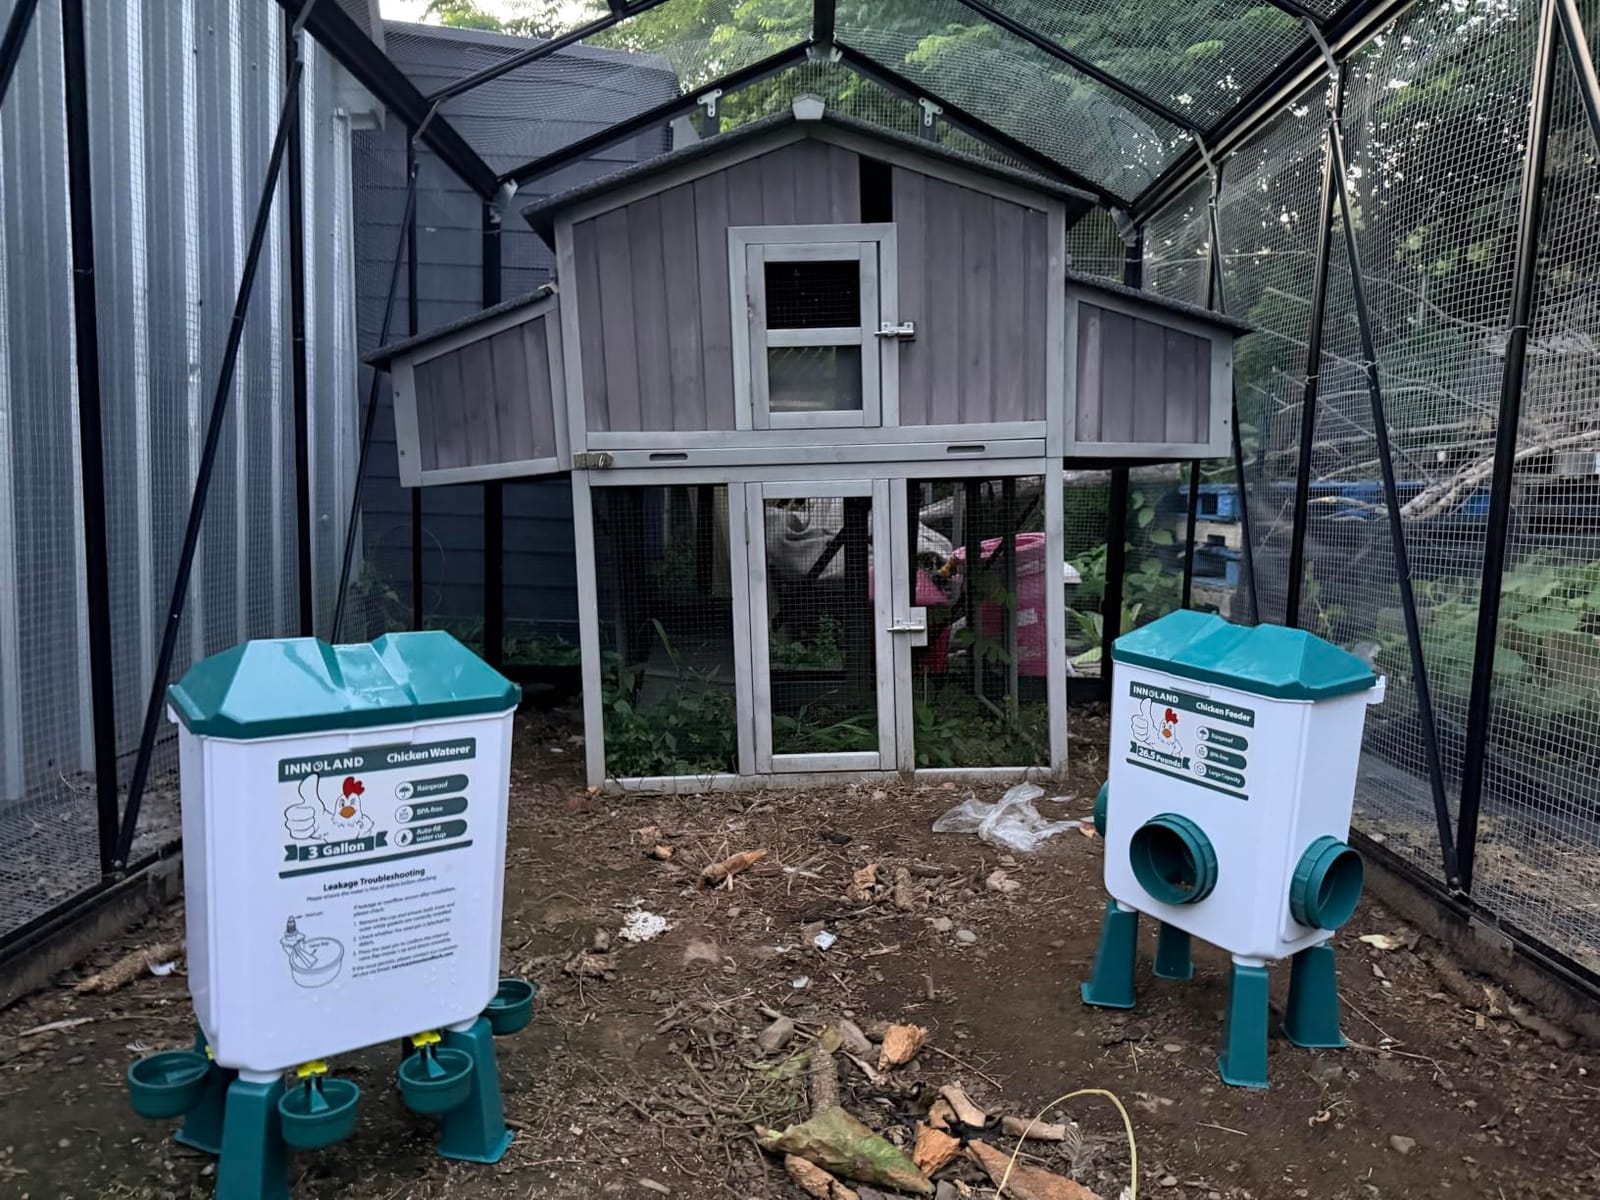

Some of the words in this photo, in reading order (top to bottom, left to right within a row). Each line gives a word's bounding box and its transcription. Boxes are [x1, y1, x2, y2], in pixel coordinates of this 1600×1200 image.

[1133, 686, 1179, 703] INNOLAND
[1196, 702, 1224, 715] Chicken
[1225, 709, 1251, 722] Feeder
[387, 748, 429, 764] Chicken
[430, 744, 470, 757] Waterer
[1138, 748, 1156, 759] 26.5
[1156, 754, 1181, 768] Pounds
[285, 756, 364, 775] INNOLAND
[417, 780, 448, 792] Rainproof
[416, 834, 434, 842] water
[435, 832, 447, 840] cup
[308, 846, 318, 859] 3
[322, 840, 365, 857] Gallon
[323, 880, 358, 892] Leakage
[360, 868, 426, 885] Troubleshooting
